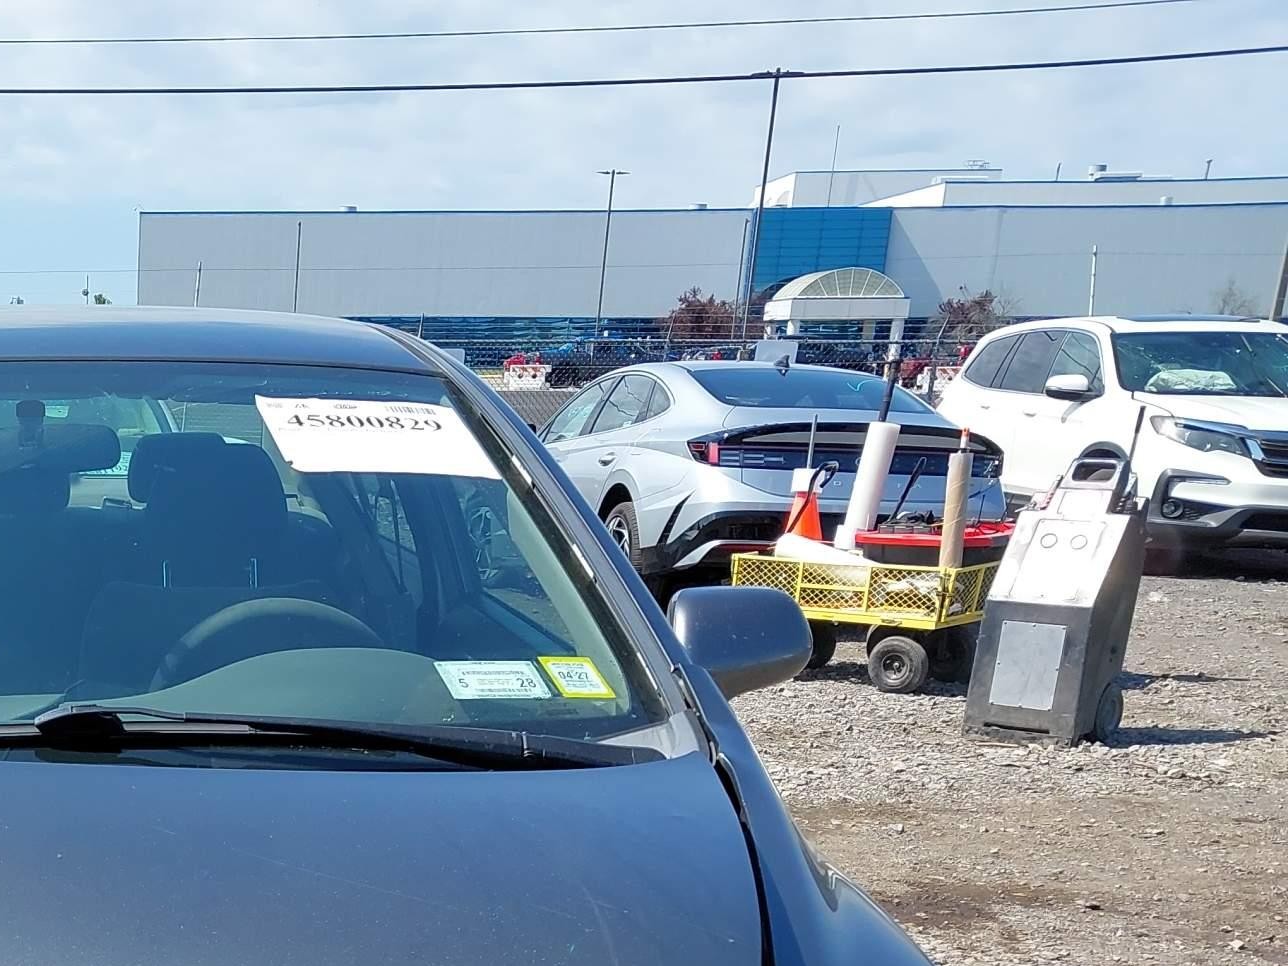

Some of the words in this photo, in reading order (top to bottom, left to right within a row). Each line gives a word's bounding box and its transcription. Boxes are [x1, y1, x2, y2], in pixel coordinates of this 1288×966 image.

[287, 413, 443, 432] 45800829
[459, 677, 469, 688] 5
[517, 677, 537, 688] 28
